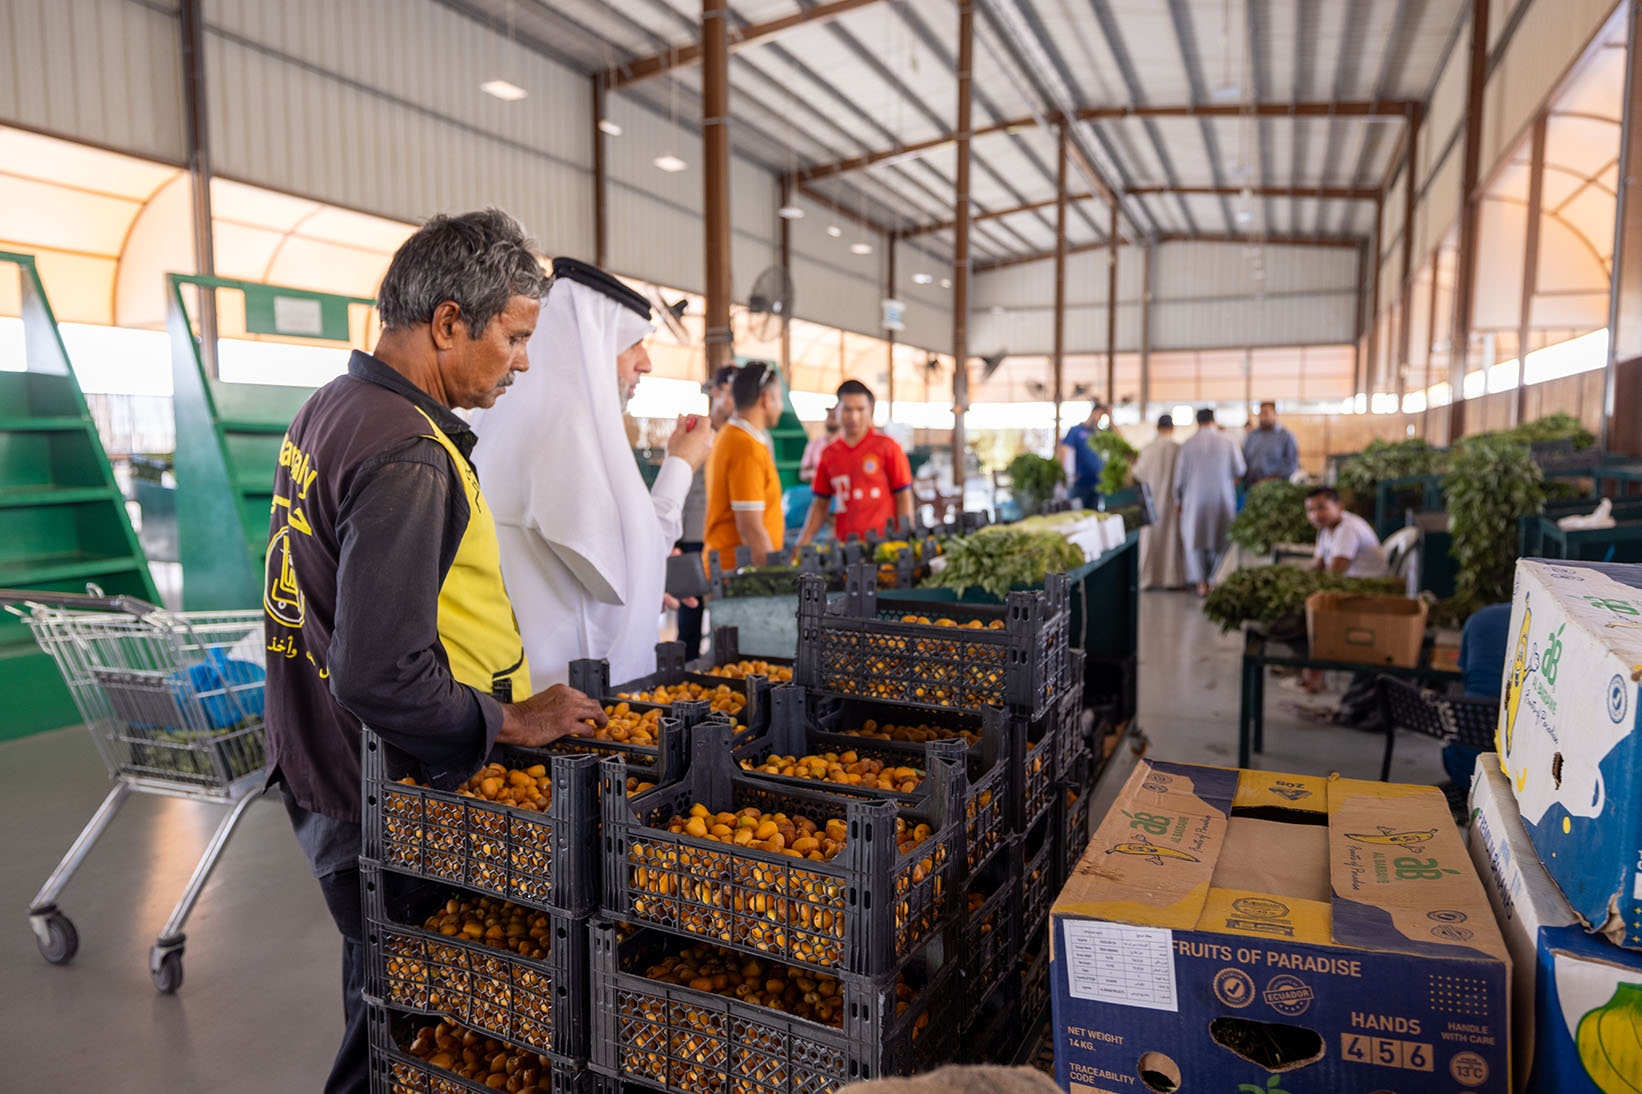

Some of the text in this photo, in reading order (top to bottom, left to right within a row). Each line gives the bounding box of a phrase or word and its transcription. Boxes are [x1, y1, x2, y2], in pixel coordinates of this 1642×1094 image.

[1237, 948, 1261, 965] OF
[1267, 951, 1362, 978] PARADISE
[1267, 989, 1310, 1002] ECUADOR
[1351, 1011, 1421, 1035] HANDS
[1447, 1021, 1489, 1035] HANDLE
[1067, 1026, 1124, 1045] NET WEIGHT
[1441, 1031, 1496, 1046] WITH CARE
[1347, 1037, 1426, 1068] 4 5 6
[1069, 1062, 1135, 1085] TRACEABILITY
[1070, 1071, 1095, 1084] CODE
